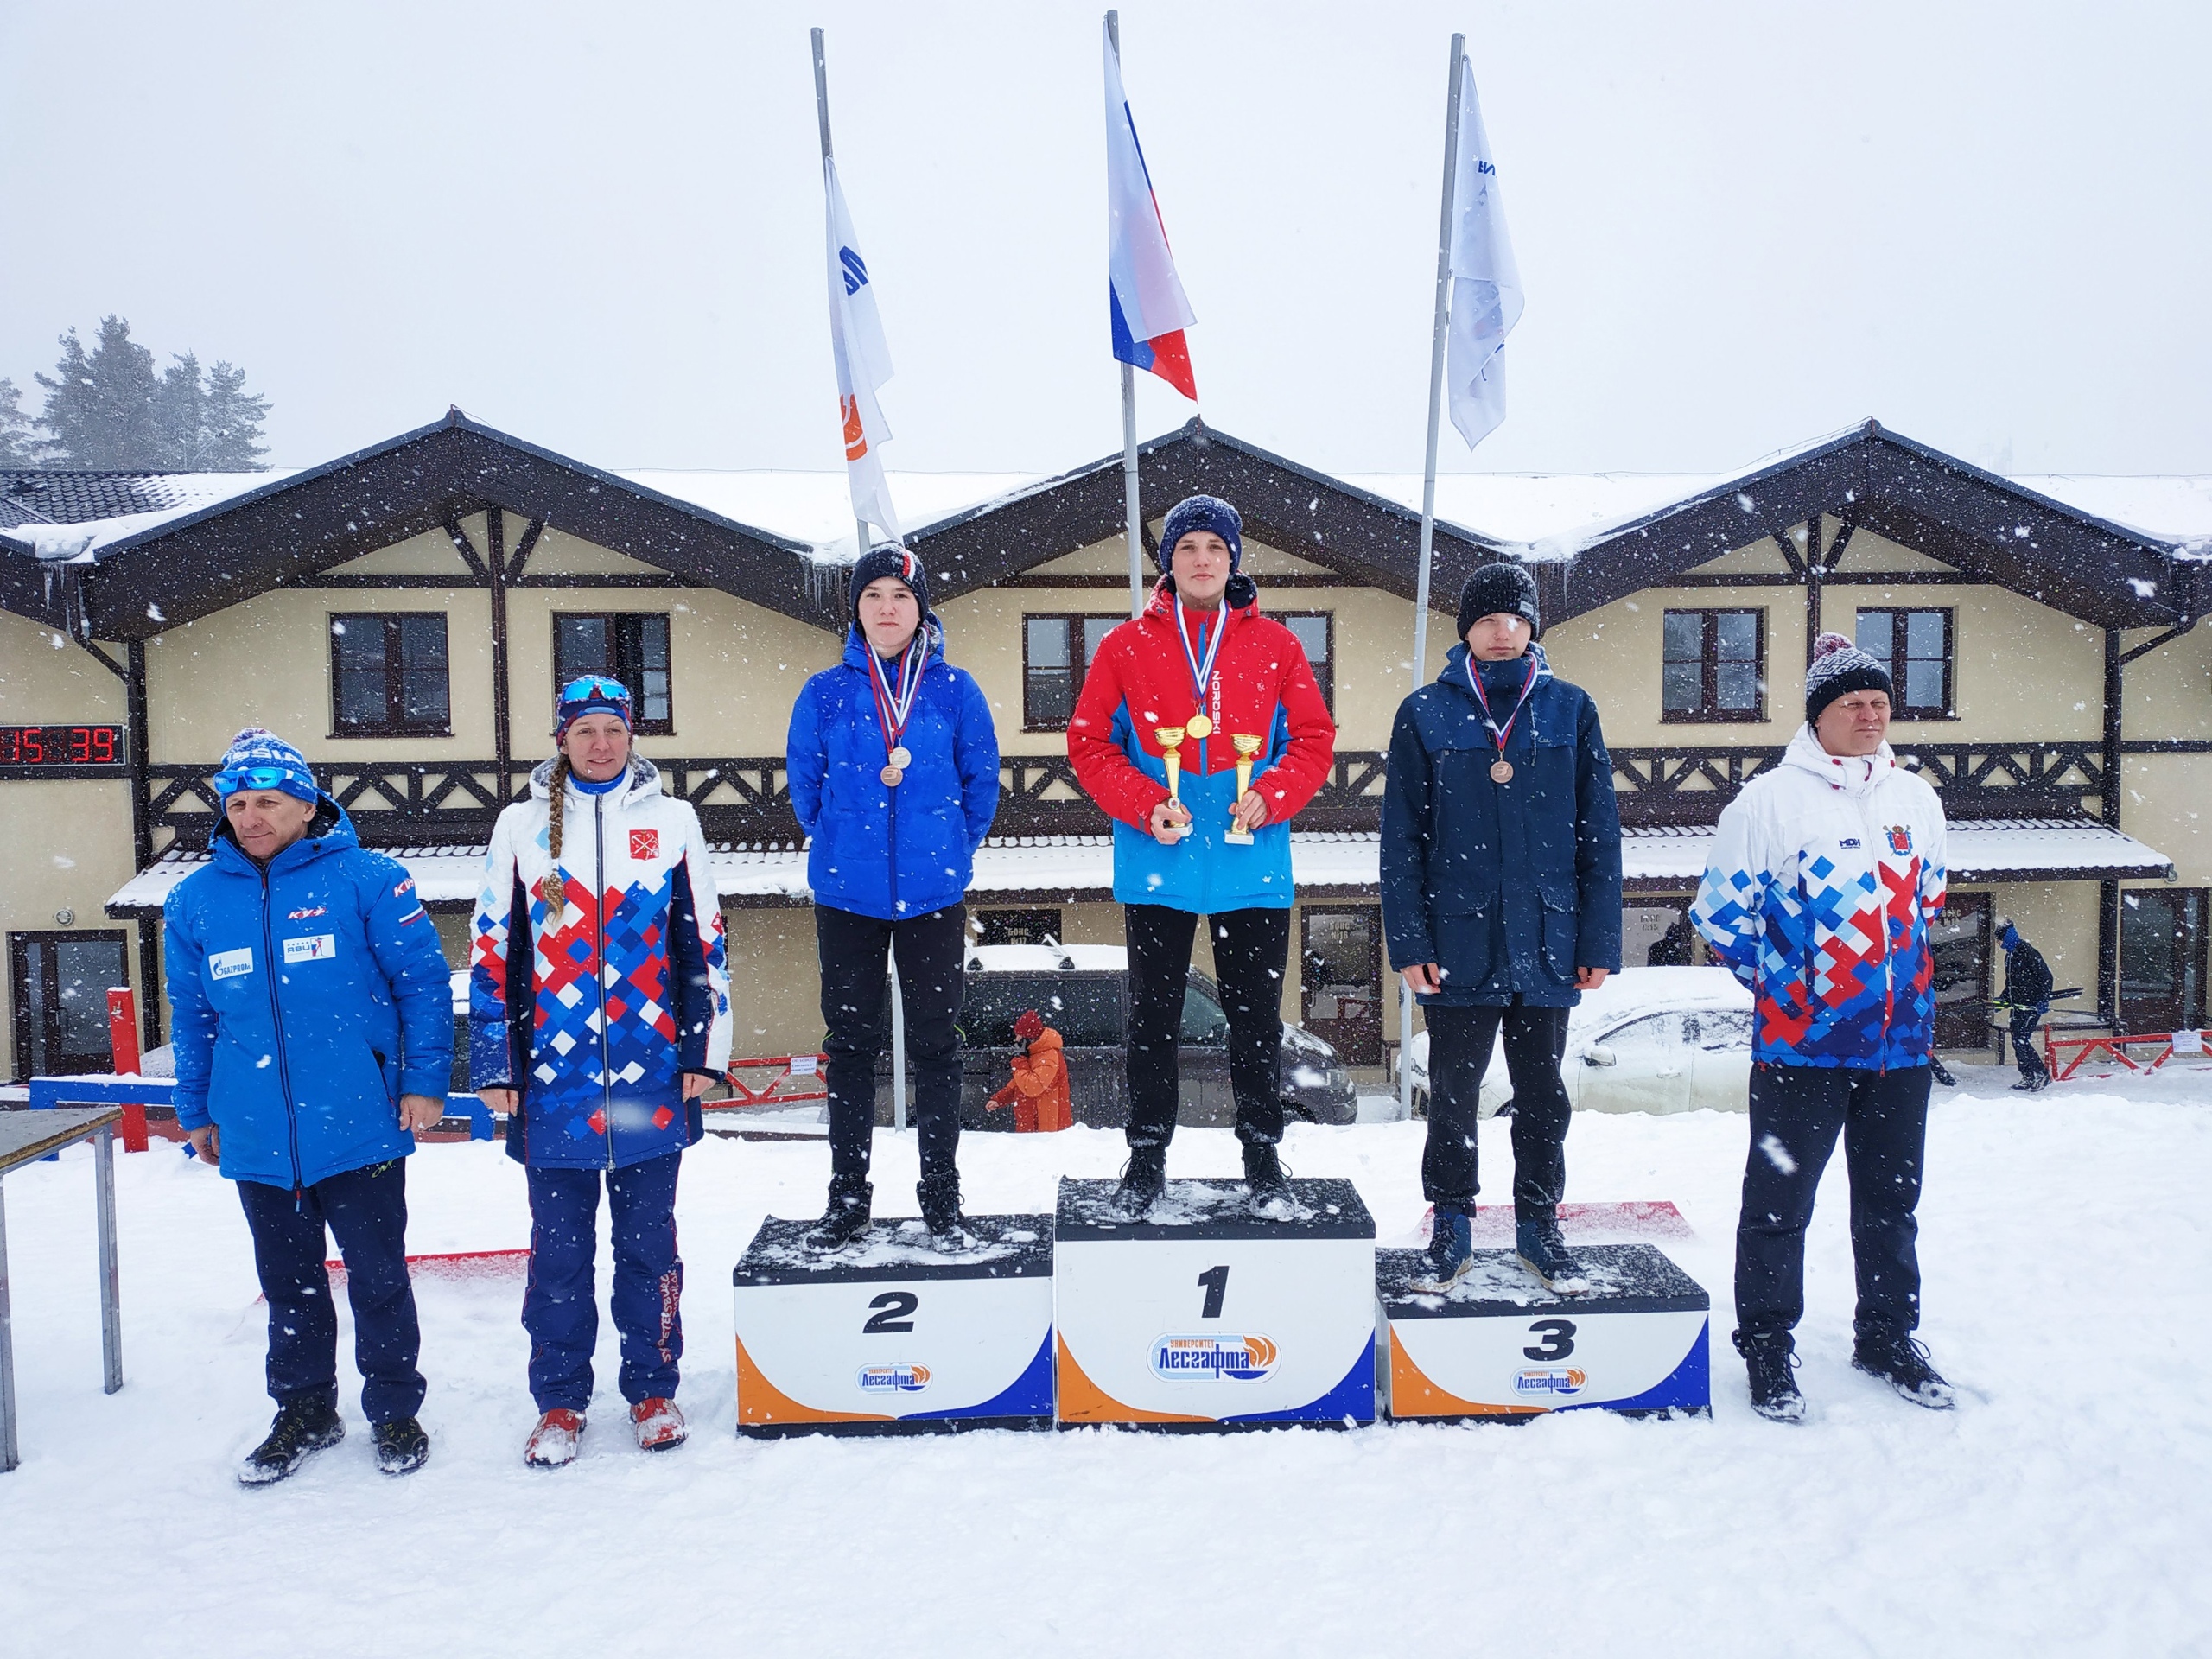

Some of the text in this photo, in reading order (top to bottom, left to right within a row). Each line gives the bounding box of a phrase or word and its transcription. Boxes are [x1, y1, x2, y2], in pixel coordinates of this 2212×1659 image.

[1211, 670, 1222, 734] NORDSKI
[15, 728, 113, 762] 15 39
[221, 747, 306, 768] SSIA
[287, 944, 311, 953] RBU
[1198, 1265, 1230, 1318] 1
[862, 1291, 919, 1333] 2
[1170, 1339, 1215, 1349] УНИВЕРСИТЕТ
[1522, 1319, 1578, 1361] 3
[1159, 1343, 1250, 1380] Лесгафта
[862, 1370, 915, 1391] Лесгафта
[1517, 1373, 1571, 1394] Лесгафта
